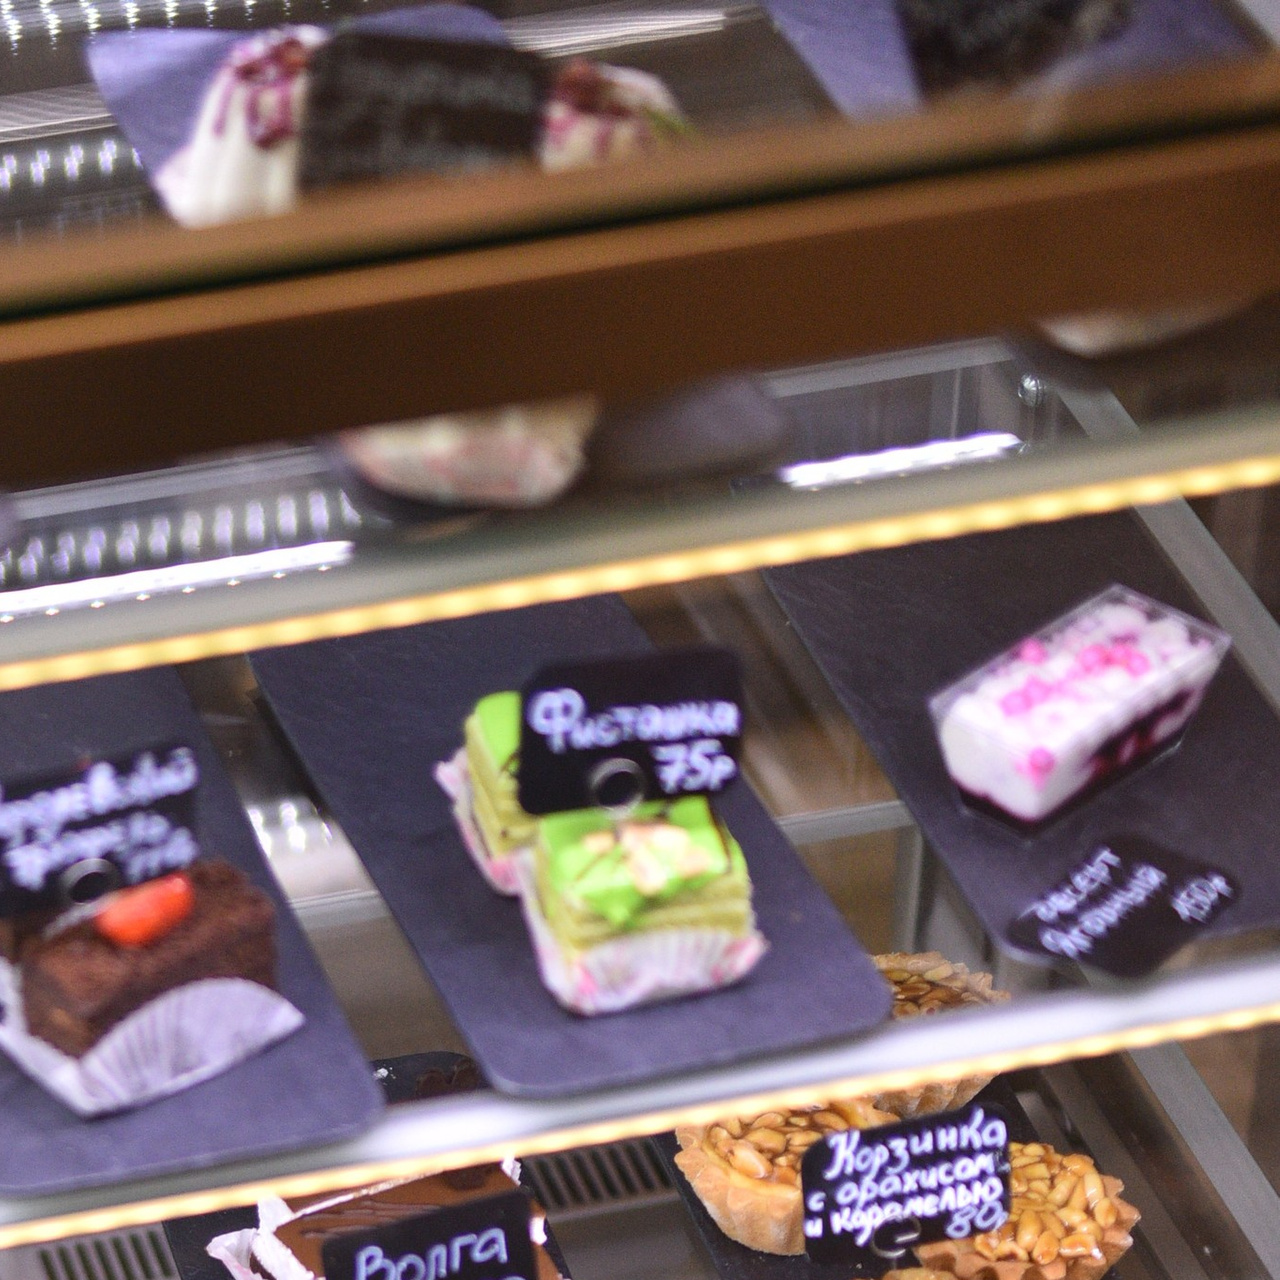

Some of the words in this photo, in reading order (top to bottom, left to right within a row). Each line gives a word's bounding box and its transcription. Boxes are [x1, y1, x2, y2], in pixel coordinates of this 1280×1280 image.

[528, 688, 741, 754] Фисташка
[652, 738, 737, 793] 75р
[824, 1107, 1007, 1180] Корзинка
[804, 1217, 822, 1237] и
[830, 1176, 1004, 1246] карамелью
[807, 1192, 826, 1212] с
[945, 1200, 1008, 1238] 80р
